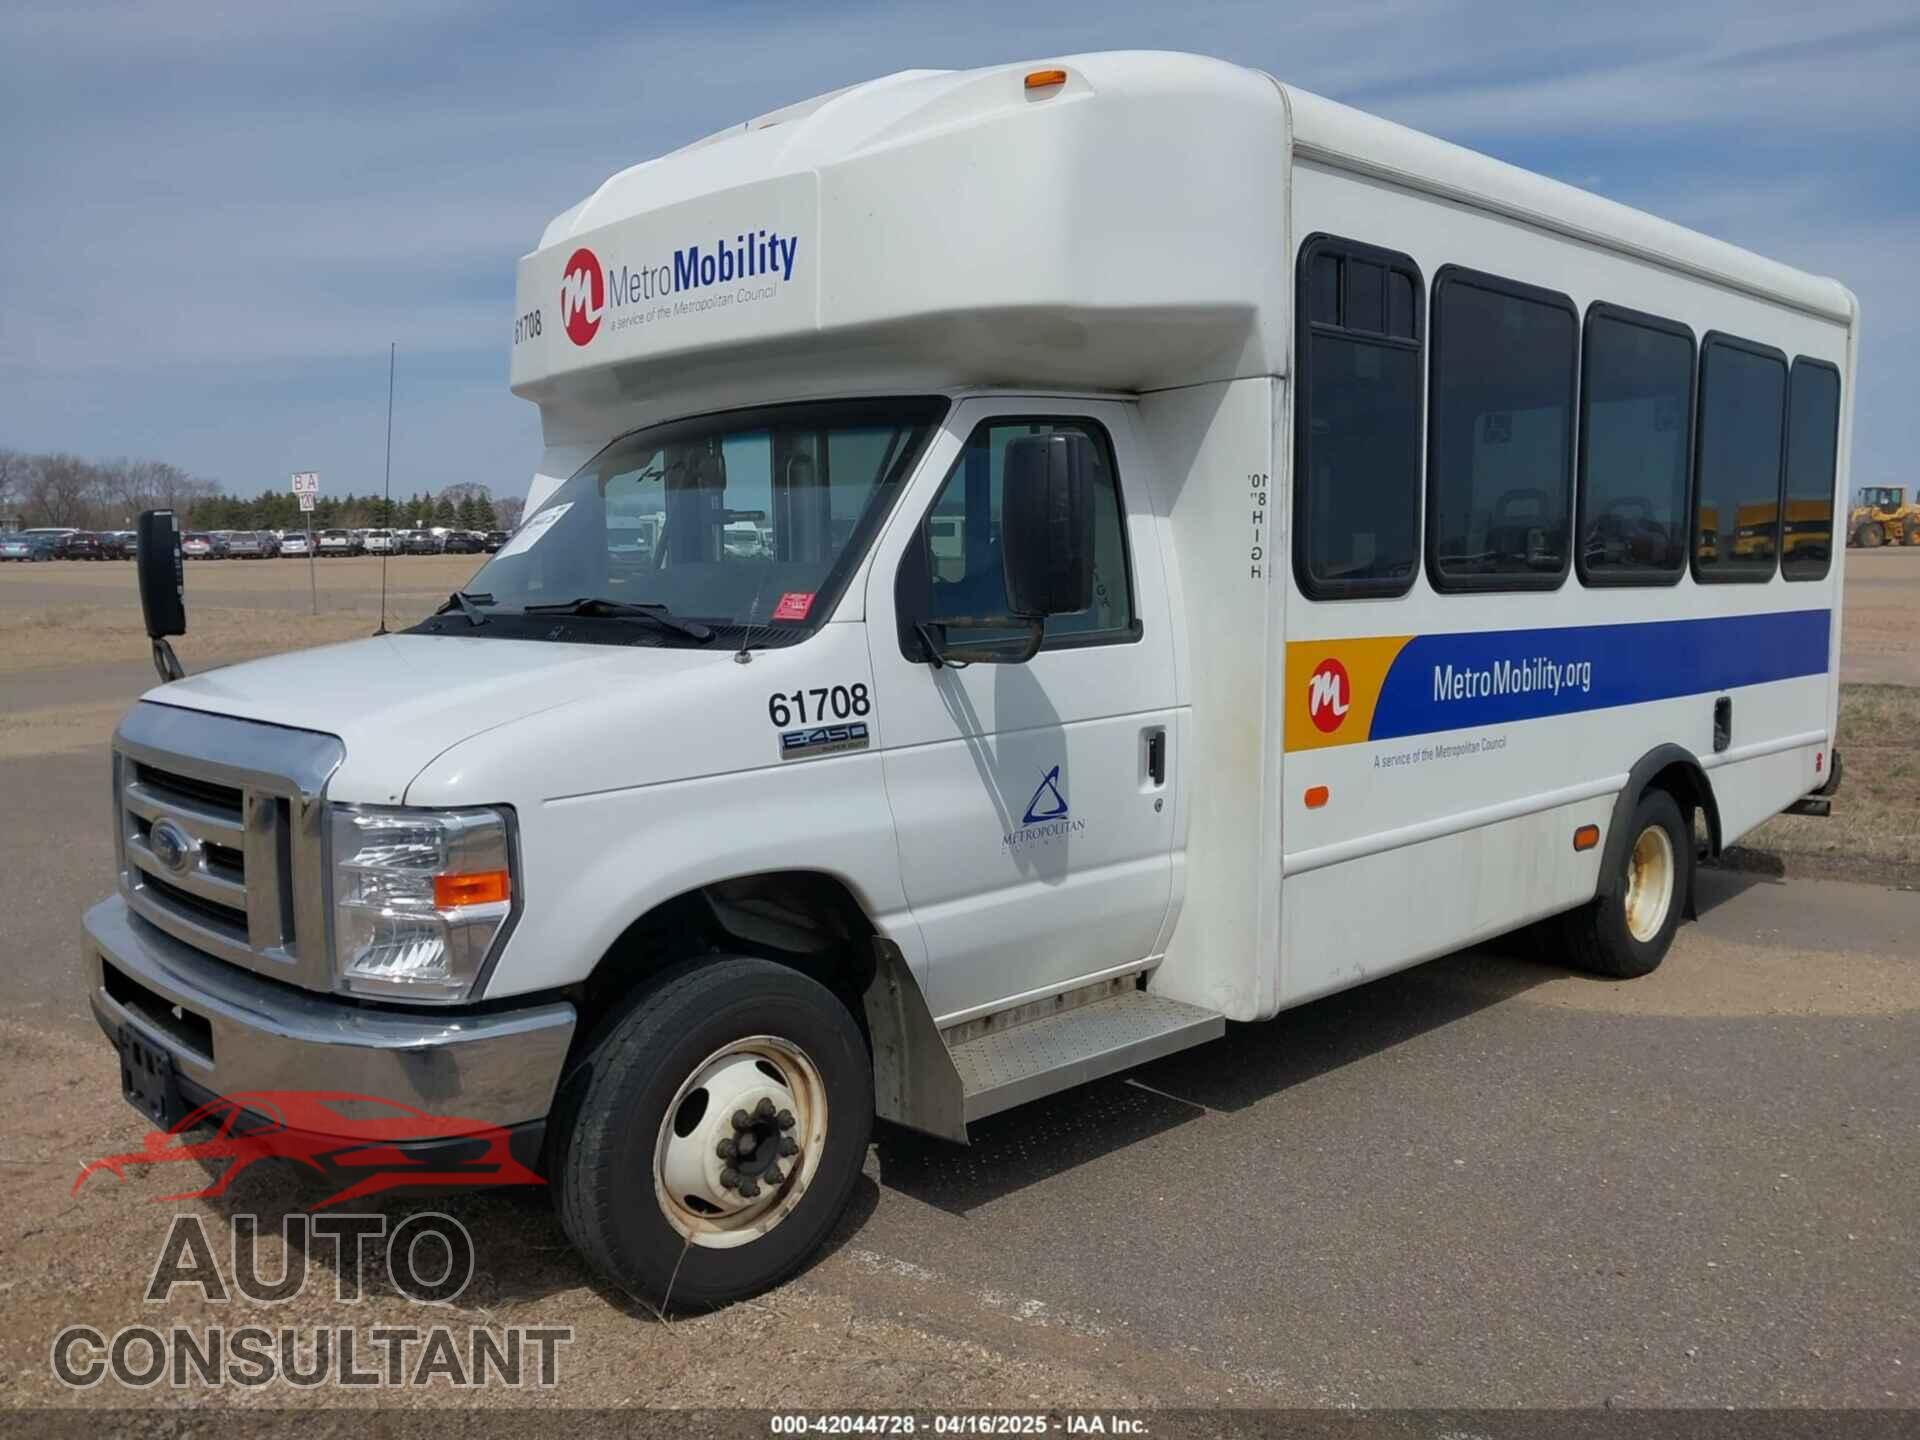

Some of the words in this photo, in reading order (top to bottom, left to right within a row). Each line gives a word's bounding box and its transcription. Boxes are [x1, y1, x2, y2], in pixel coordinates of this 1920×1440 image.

[609, 230, 798, 309] MetroMobility
[617, 314, 645, 331] service
[646, 308, 657, 323] of
[657, 304, 671, 320] the
[673, 294, 734, 318] Metropolitan
[736, 285, 778, 304] Council
[1434, 657, 1592, 702] MetroMobility.org
[768, 683, 871, 728] 61708
[1374, 755, 1381, 769] A
[1381, 753, 1411, 768] service
[1412, 748, 1421, 763] of
[1421, 747, 1433, 761] the
[1435, 740, 1480, 759] Metropolitan
[1481, 736, 1507, 752] Council
[1002, 819, 1086, 847] METROPOLITAN
